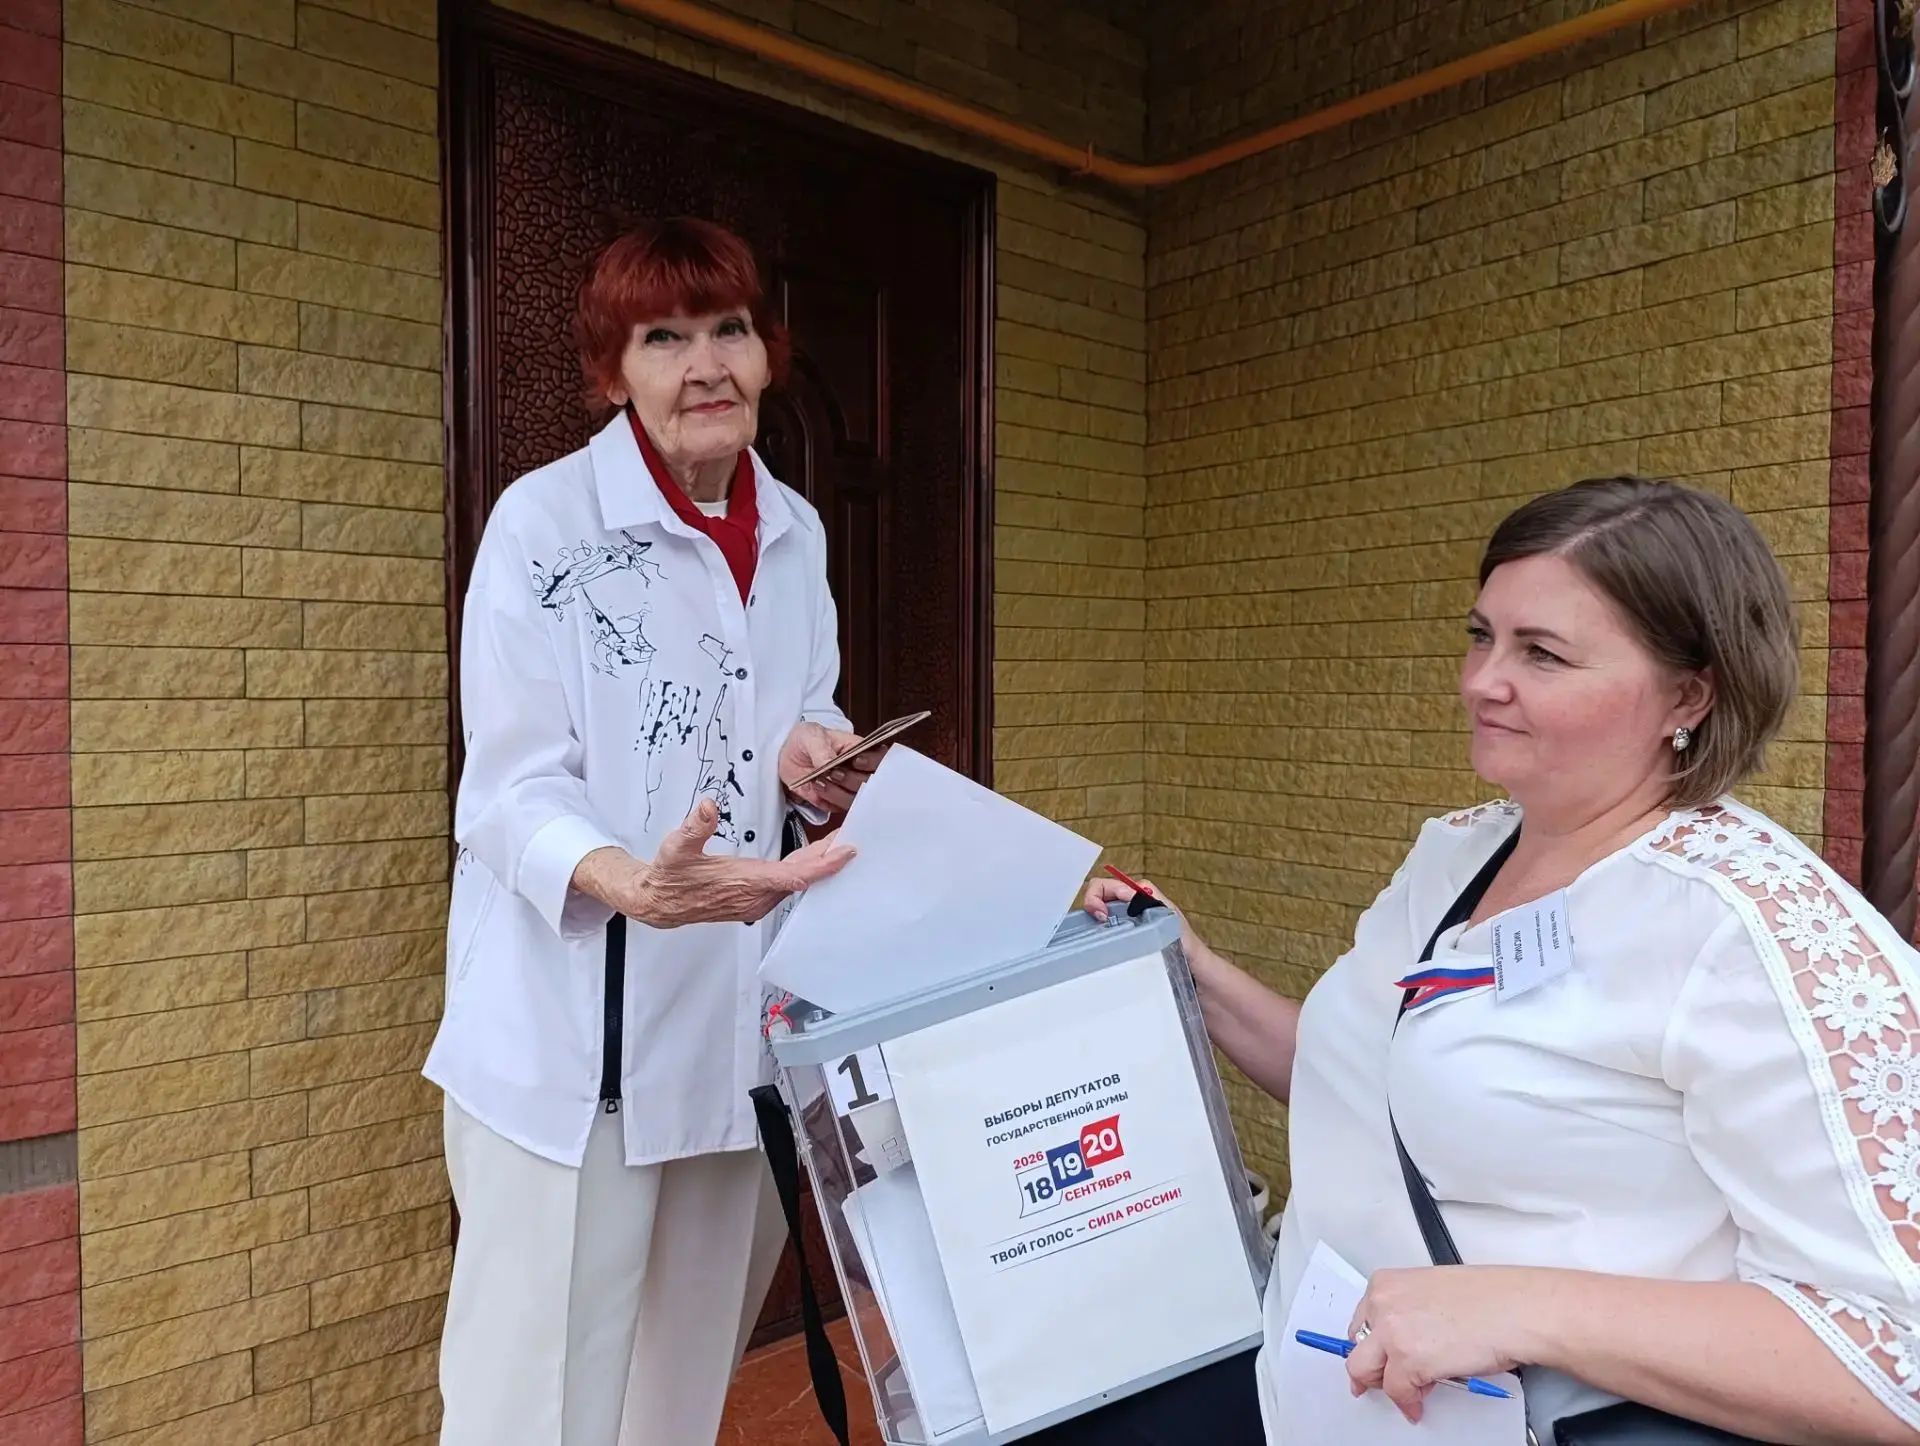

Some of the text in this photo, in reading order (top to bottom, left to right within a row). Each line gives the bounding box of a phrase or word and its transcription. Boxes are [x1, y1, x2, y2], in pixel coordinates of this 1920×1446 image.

[838, 1054, 879, 1110] 1
[984, 1073, 1121, 1128] ВЫБОРЫ ДЕПУТАТОВ
[986, 1091, 1129, 1147] ГОСУДАРСТВЕННОЙ ДУМЫ
[1013, 1151, 1044, 1170] 2026
[1024, 1128, 1117, 1204] 18 19 20
[1064, 1170, 1132, 1202] СЕНТЯБРЯ
[990, 1242, 1028, 1265] ТВОЙ
[1029, 1227, 1074, 1252] ГОЛОС
[1088, 1210, 1124, 1230] СИЛА
[1126, 1187, 1182, 1217] РОССИИ!
